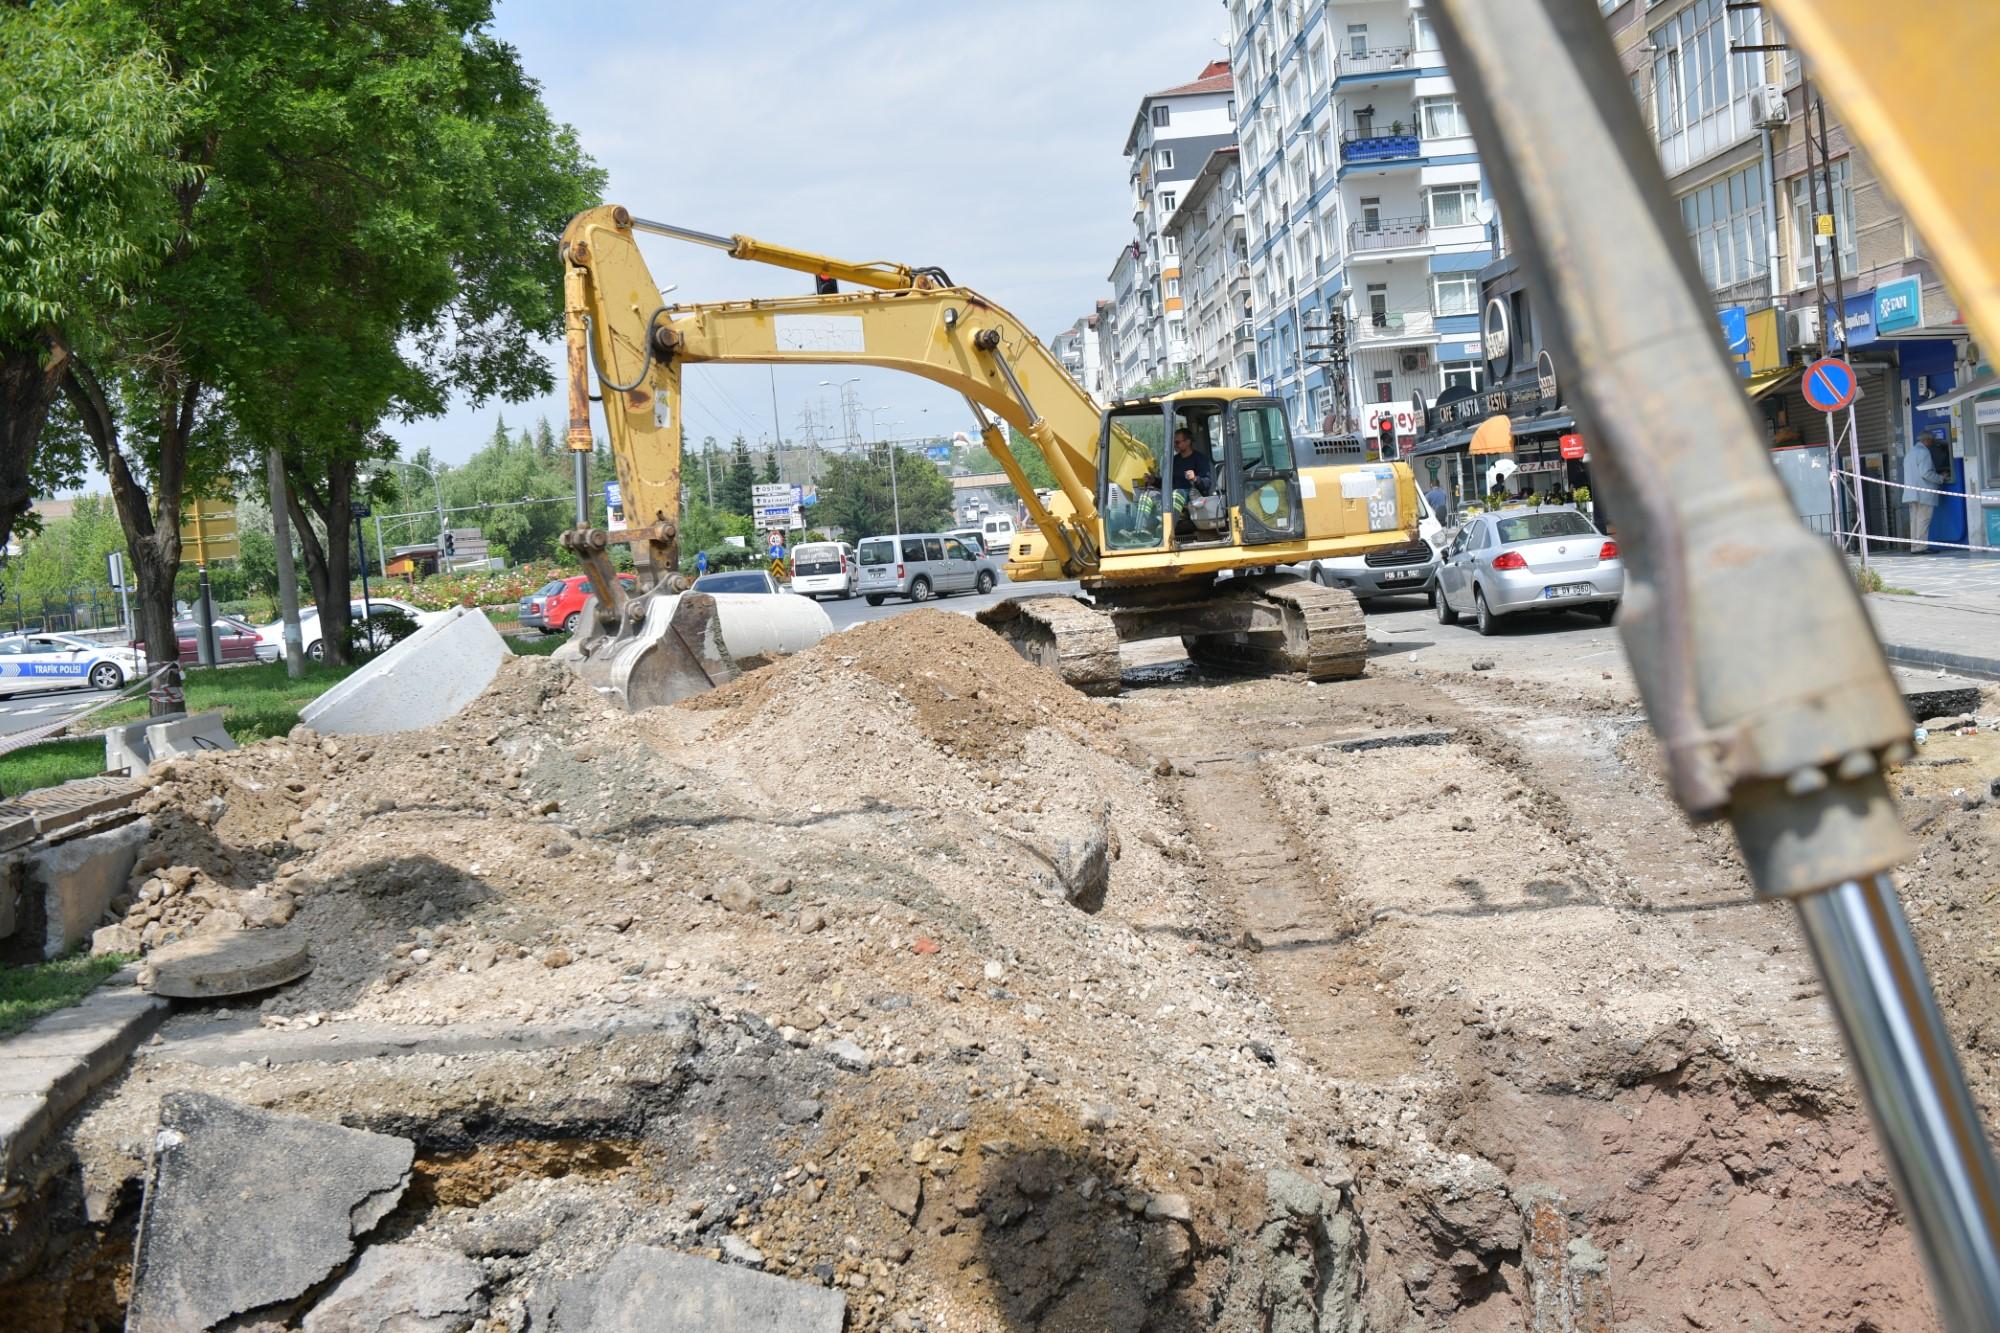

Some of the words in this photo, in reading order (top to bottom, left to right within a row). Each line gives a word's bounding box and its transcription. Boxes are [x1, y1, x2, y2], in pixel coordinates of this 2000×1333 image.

[1440, 406, 1453, 422] CAFE
[1458, 399, 1480, 418] PASTA
[1487, 392, 1508, 411] RESTO
[1370, 500, 1395, 518] 350
[1371, 520, 1381, 529] LC
[35, 664, 58, 673] TRAFİK
[60, 664, 81, 673] POLİSİ
